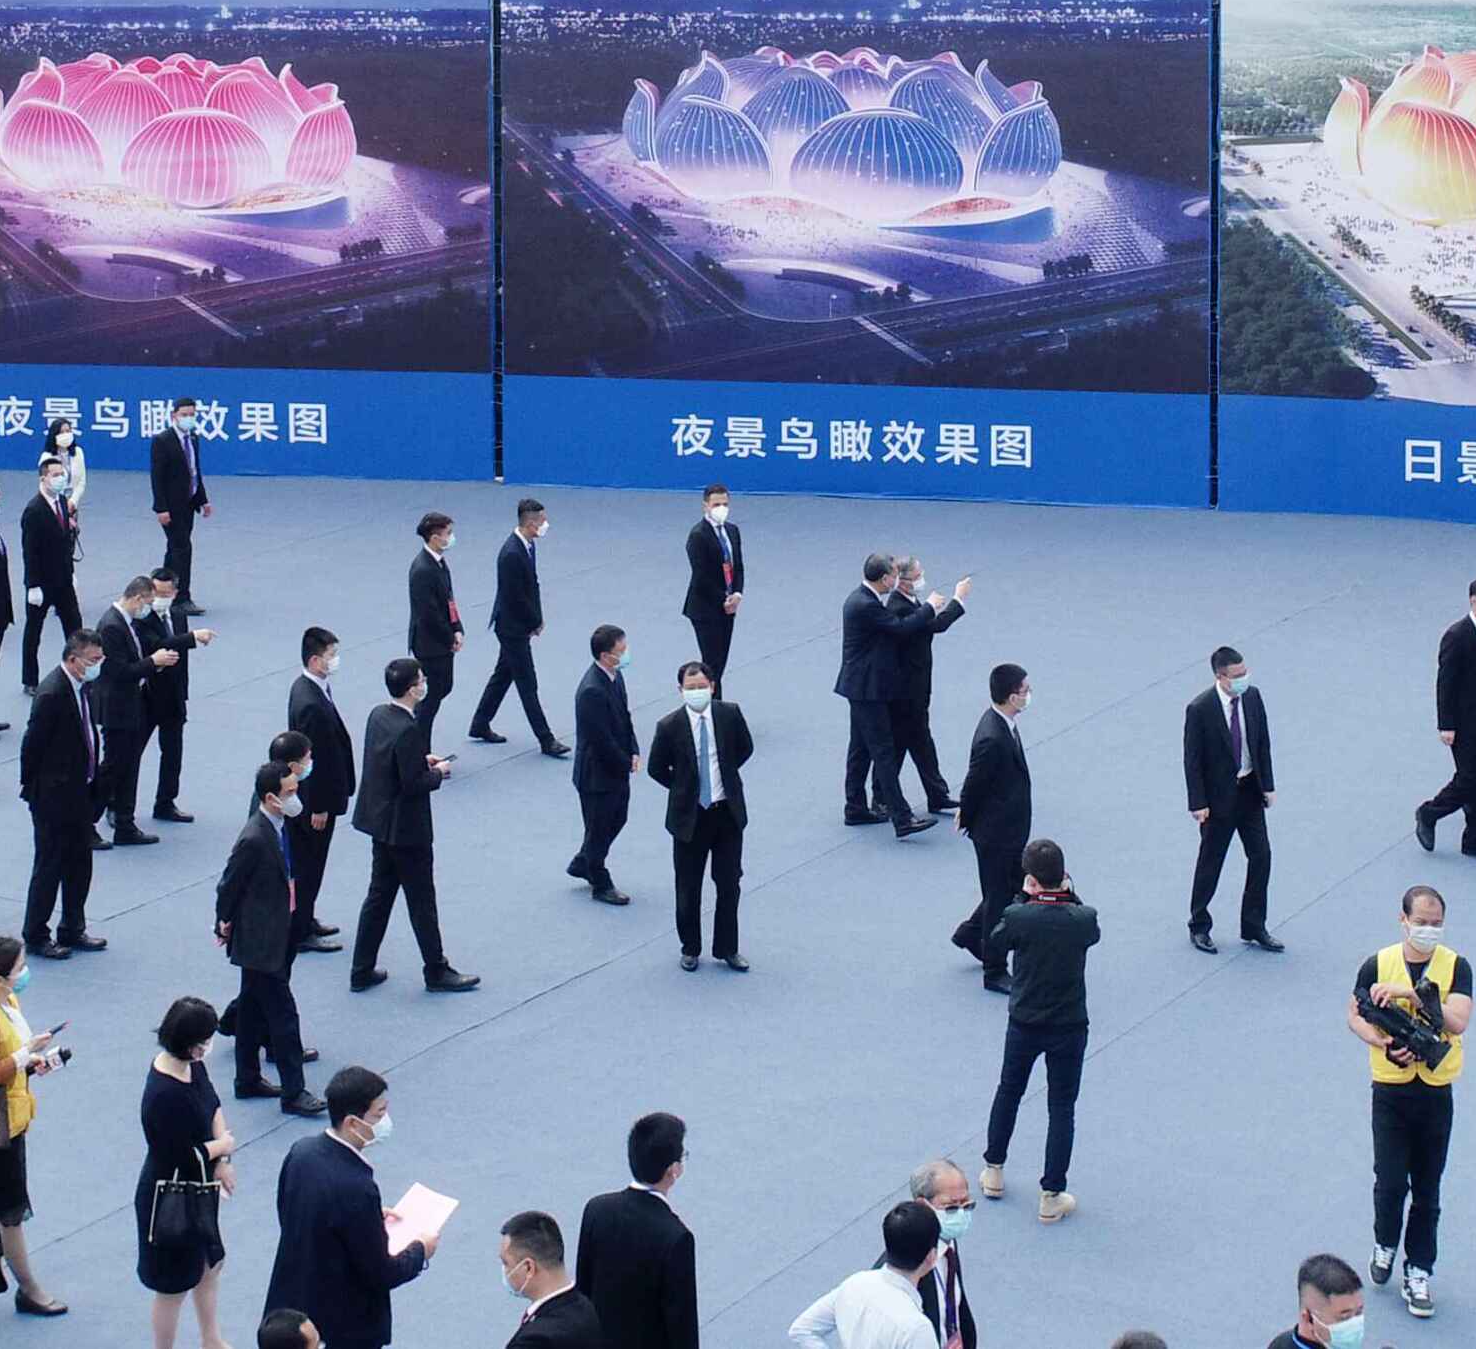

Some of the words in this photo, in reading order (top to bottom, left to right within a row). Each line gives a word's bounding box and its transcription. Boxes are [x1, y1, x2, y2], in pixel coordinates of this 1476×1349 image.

[670, 412, 1033, 468] 夜景鸟瞰效果图
